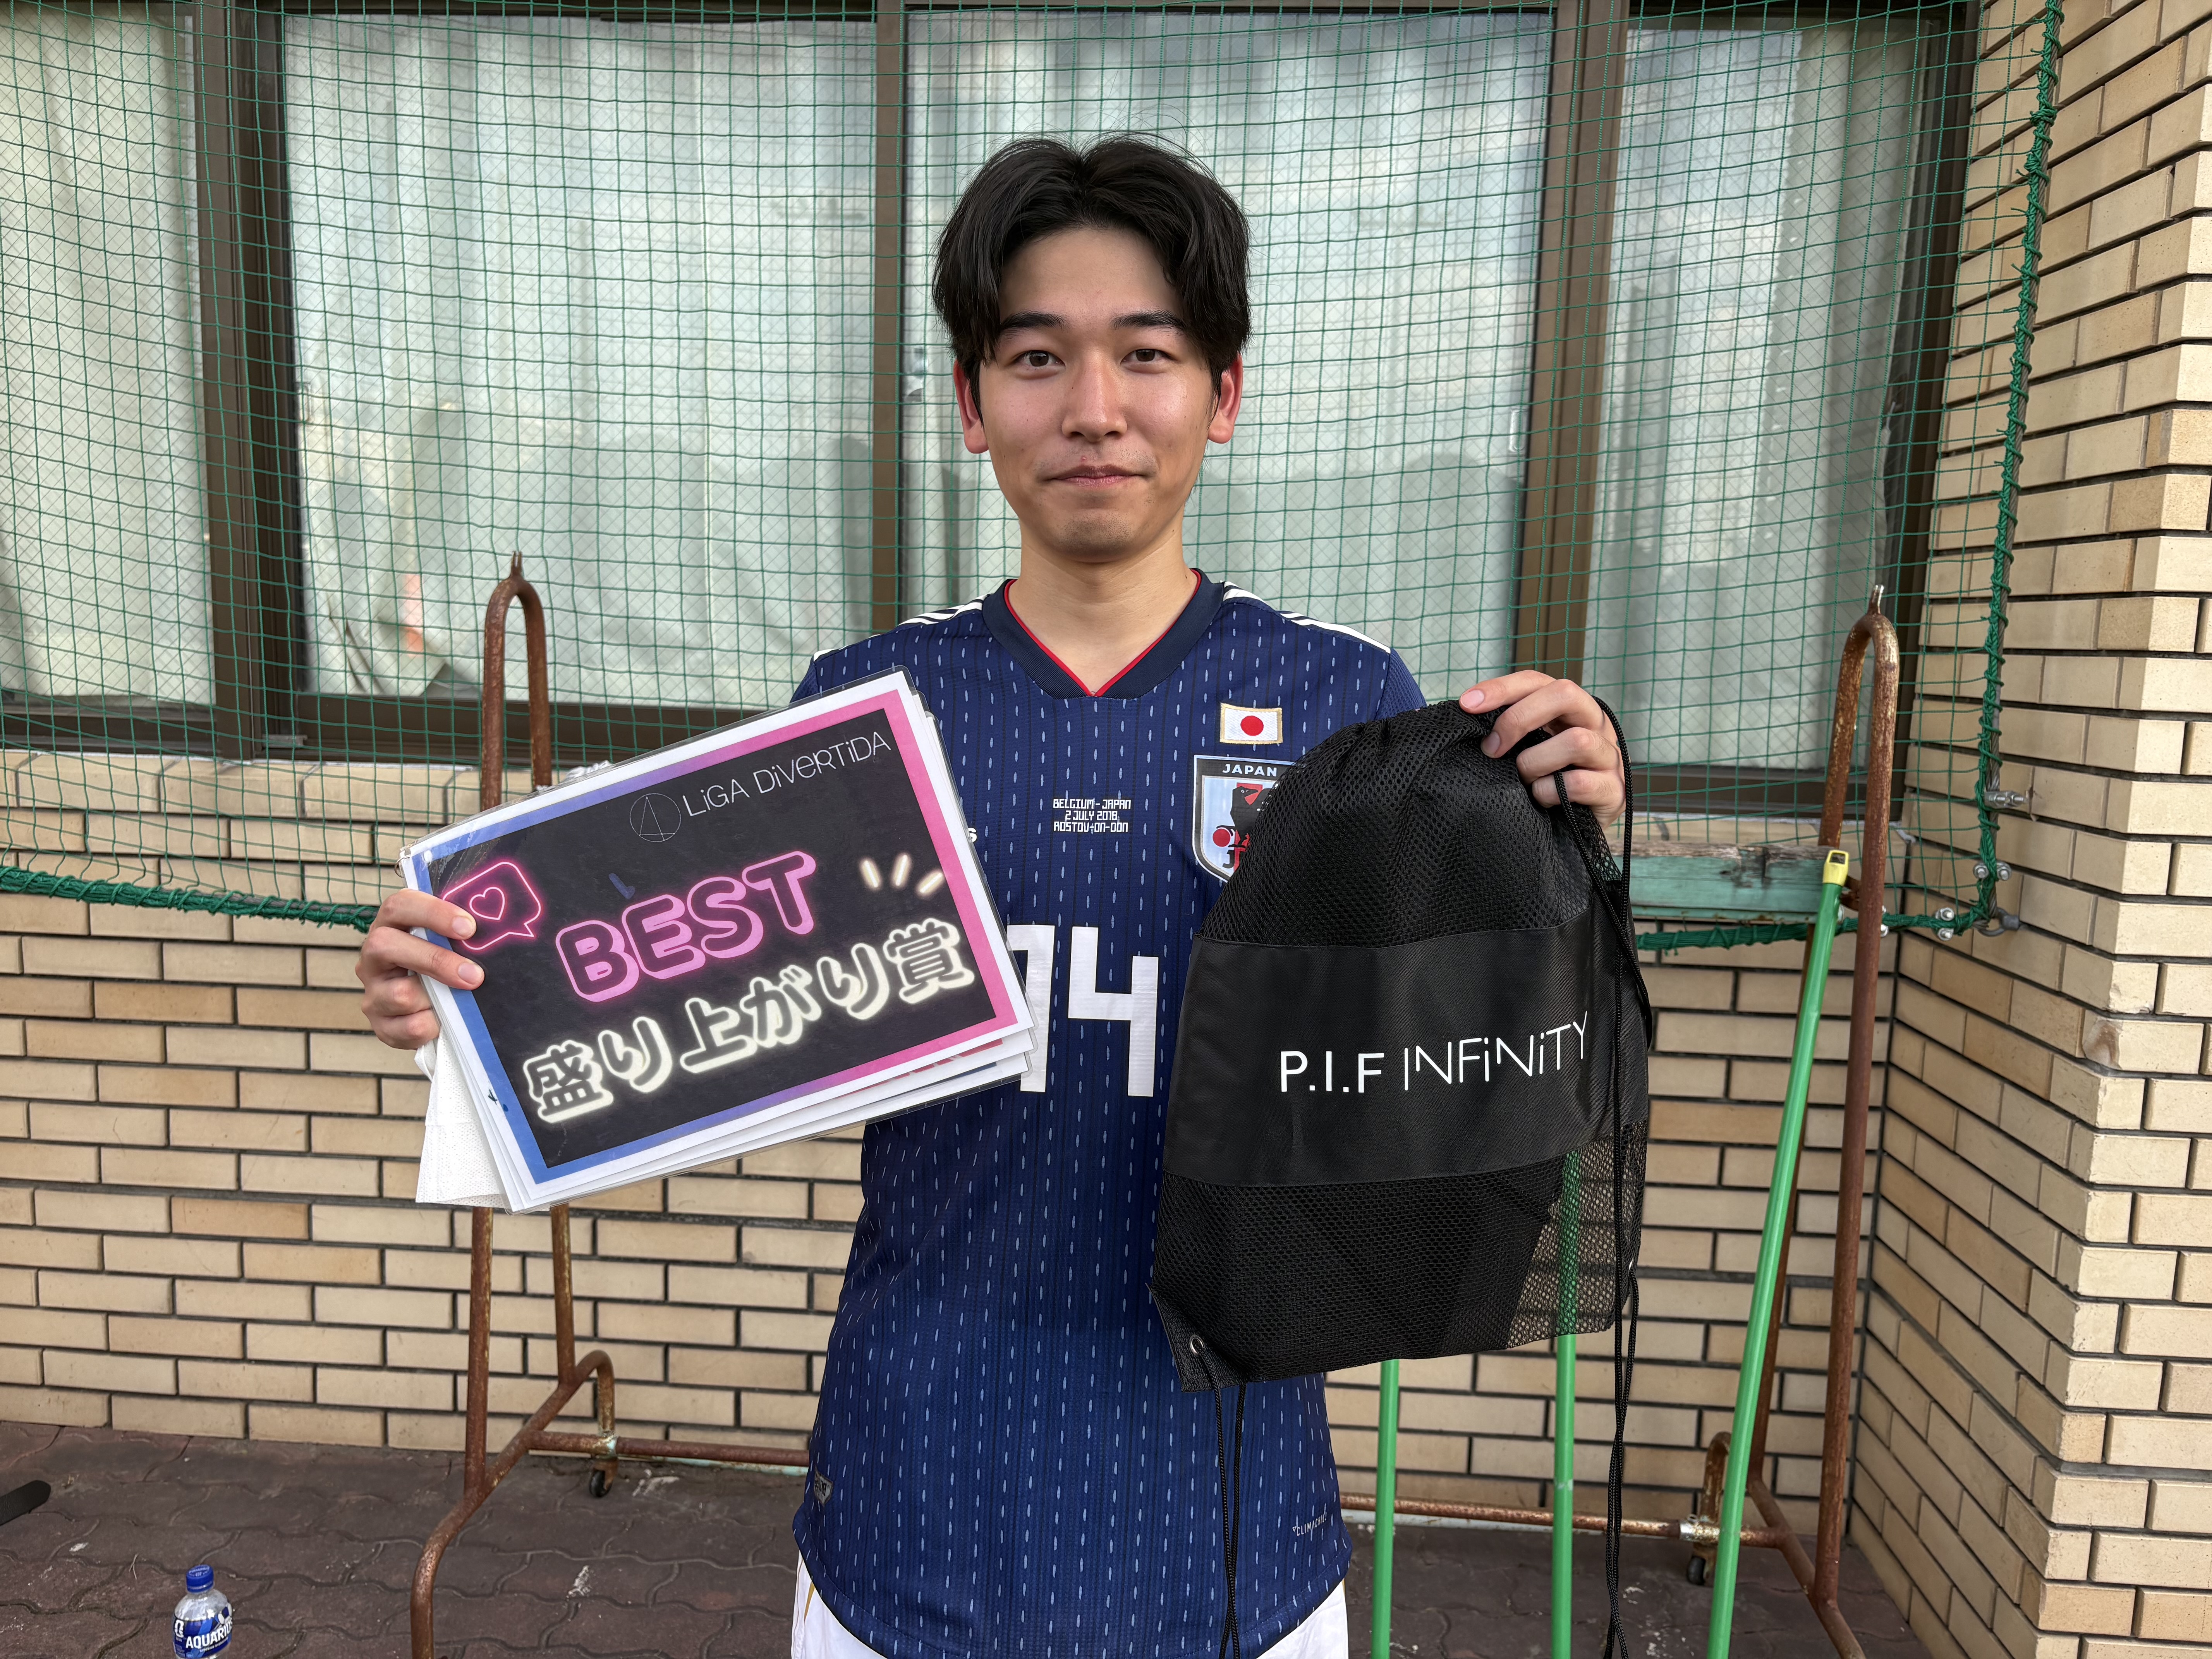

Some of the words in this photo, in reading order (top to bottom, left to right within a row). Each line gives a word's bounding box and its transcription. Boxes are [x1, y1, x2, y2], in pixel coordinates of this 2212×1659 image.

[1222, 764, 1277, 777] JAPAN
[1053, 799, 1094, 809] BELGIUM
[1102, 799, 1131, 809] JAPAN
[1066, 810, 1071, 820] 2
[1073, 811, 1094, 821] JULY
[1097, 811, 1118, 820] 2018
[555, 851, 816, 1002] BEST
[523, 918, 975, 1124] 盛り上がり賞
[1007, 924, 1159, 1097] 14
[1280, 1051, 1384, 1093] P.I.F
